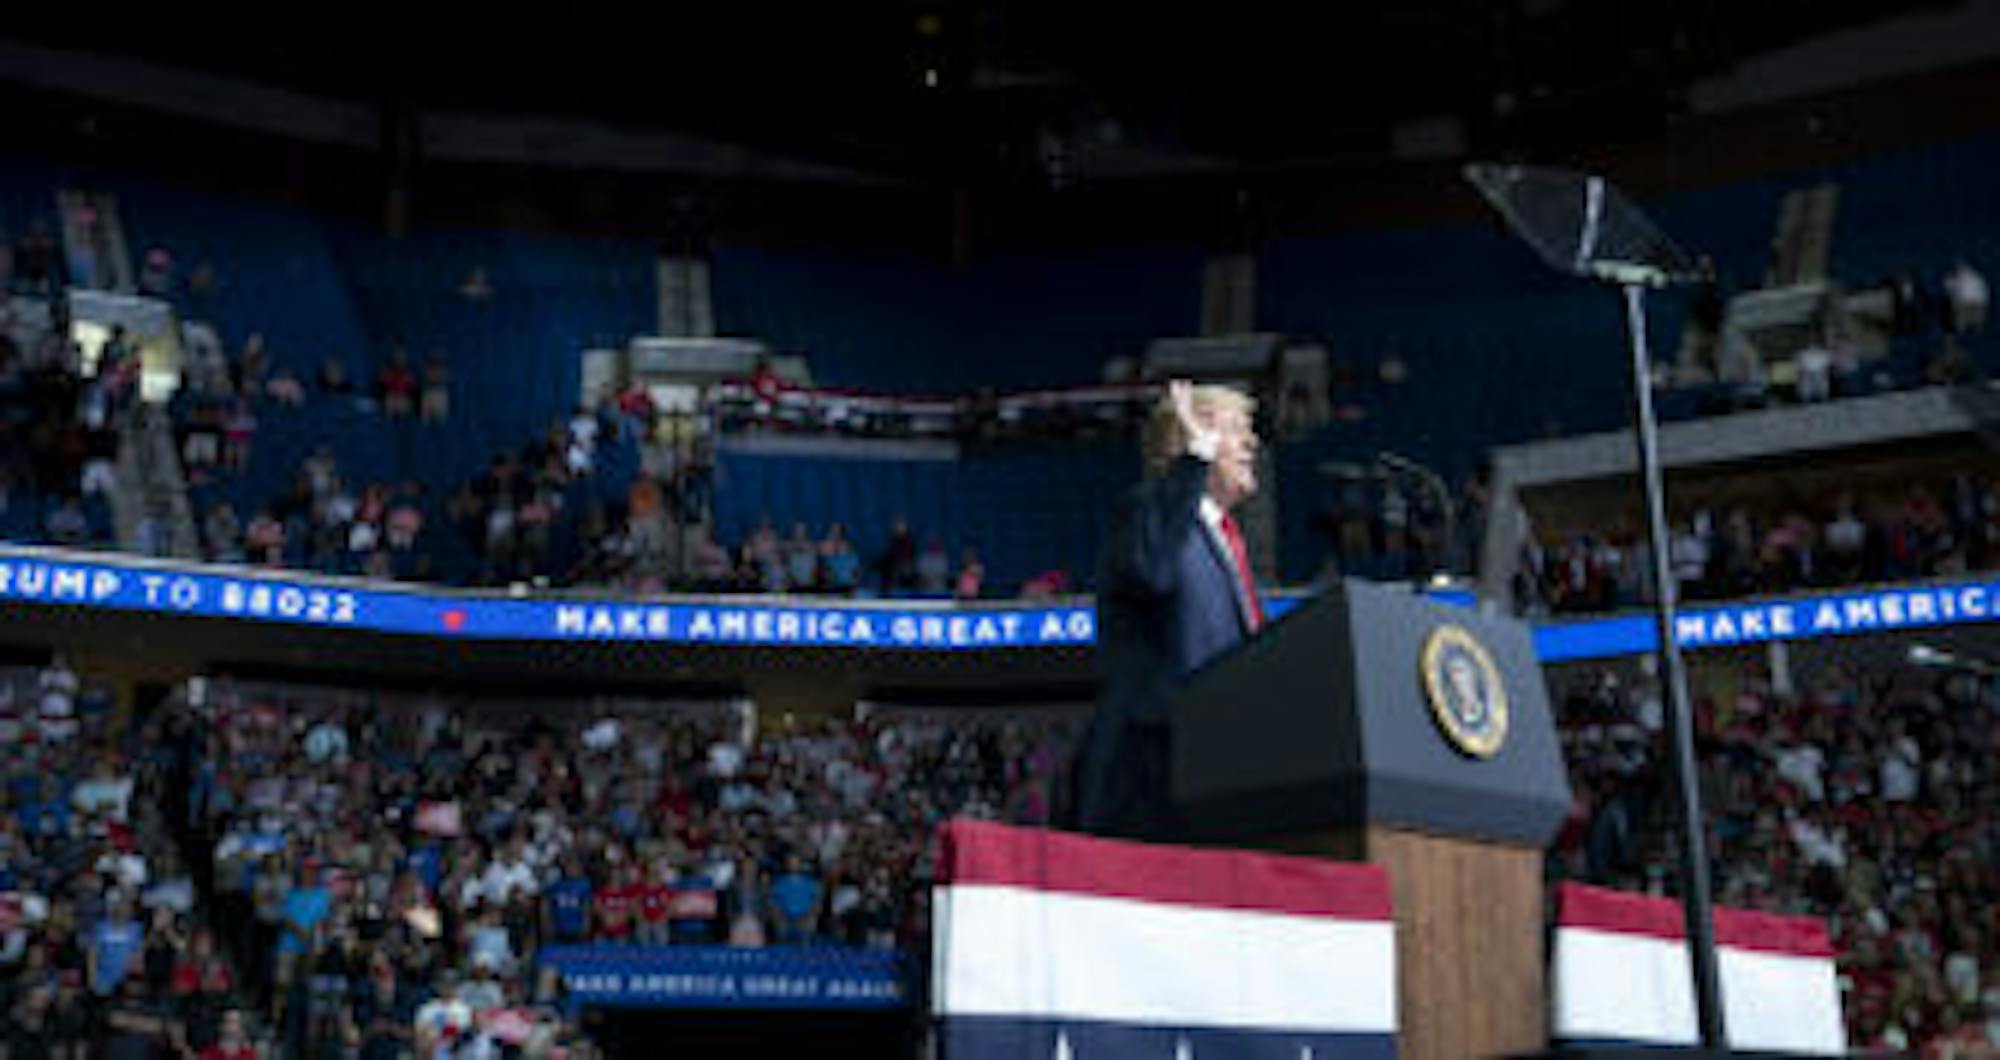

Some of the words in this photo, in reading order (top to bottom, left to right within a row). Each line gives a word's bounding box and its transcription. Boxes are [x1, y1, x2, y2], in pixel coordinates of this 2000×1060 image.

[142, 576, 199, 610] TO
[557, 605, 666, 636] MAKE
[688, 609, 873, 641] AMERICA
[891, 615, 1020, 645] GREAT
[1676, 606, 1794, 642] MAKE
[1814, 587, 2000, 629] AMERIC
